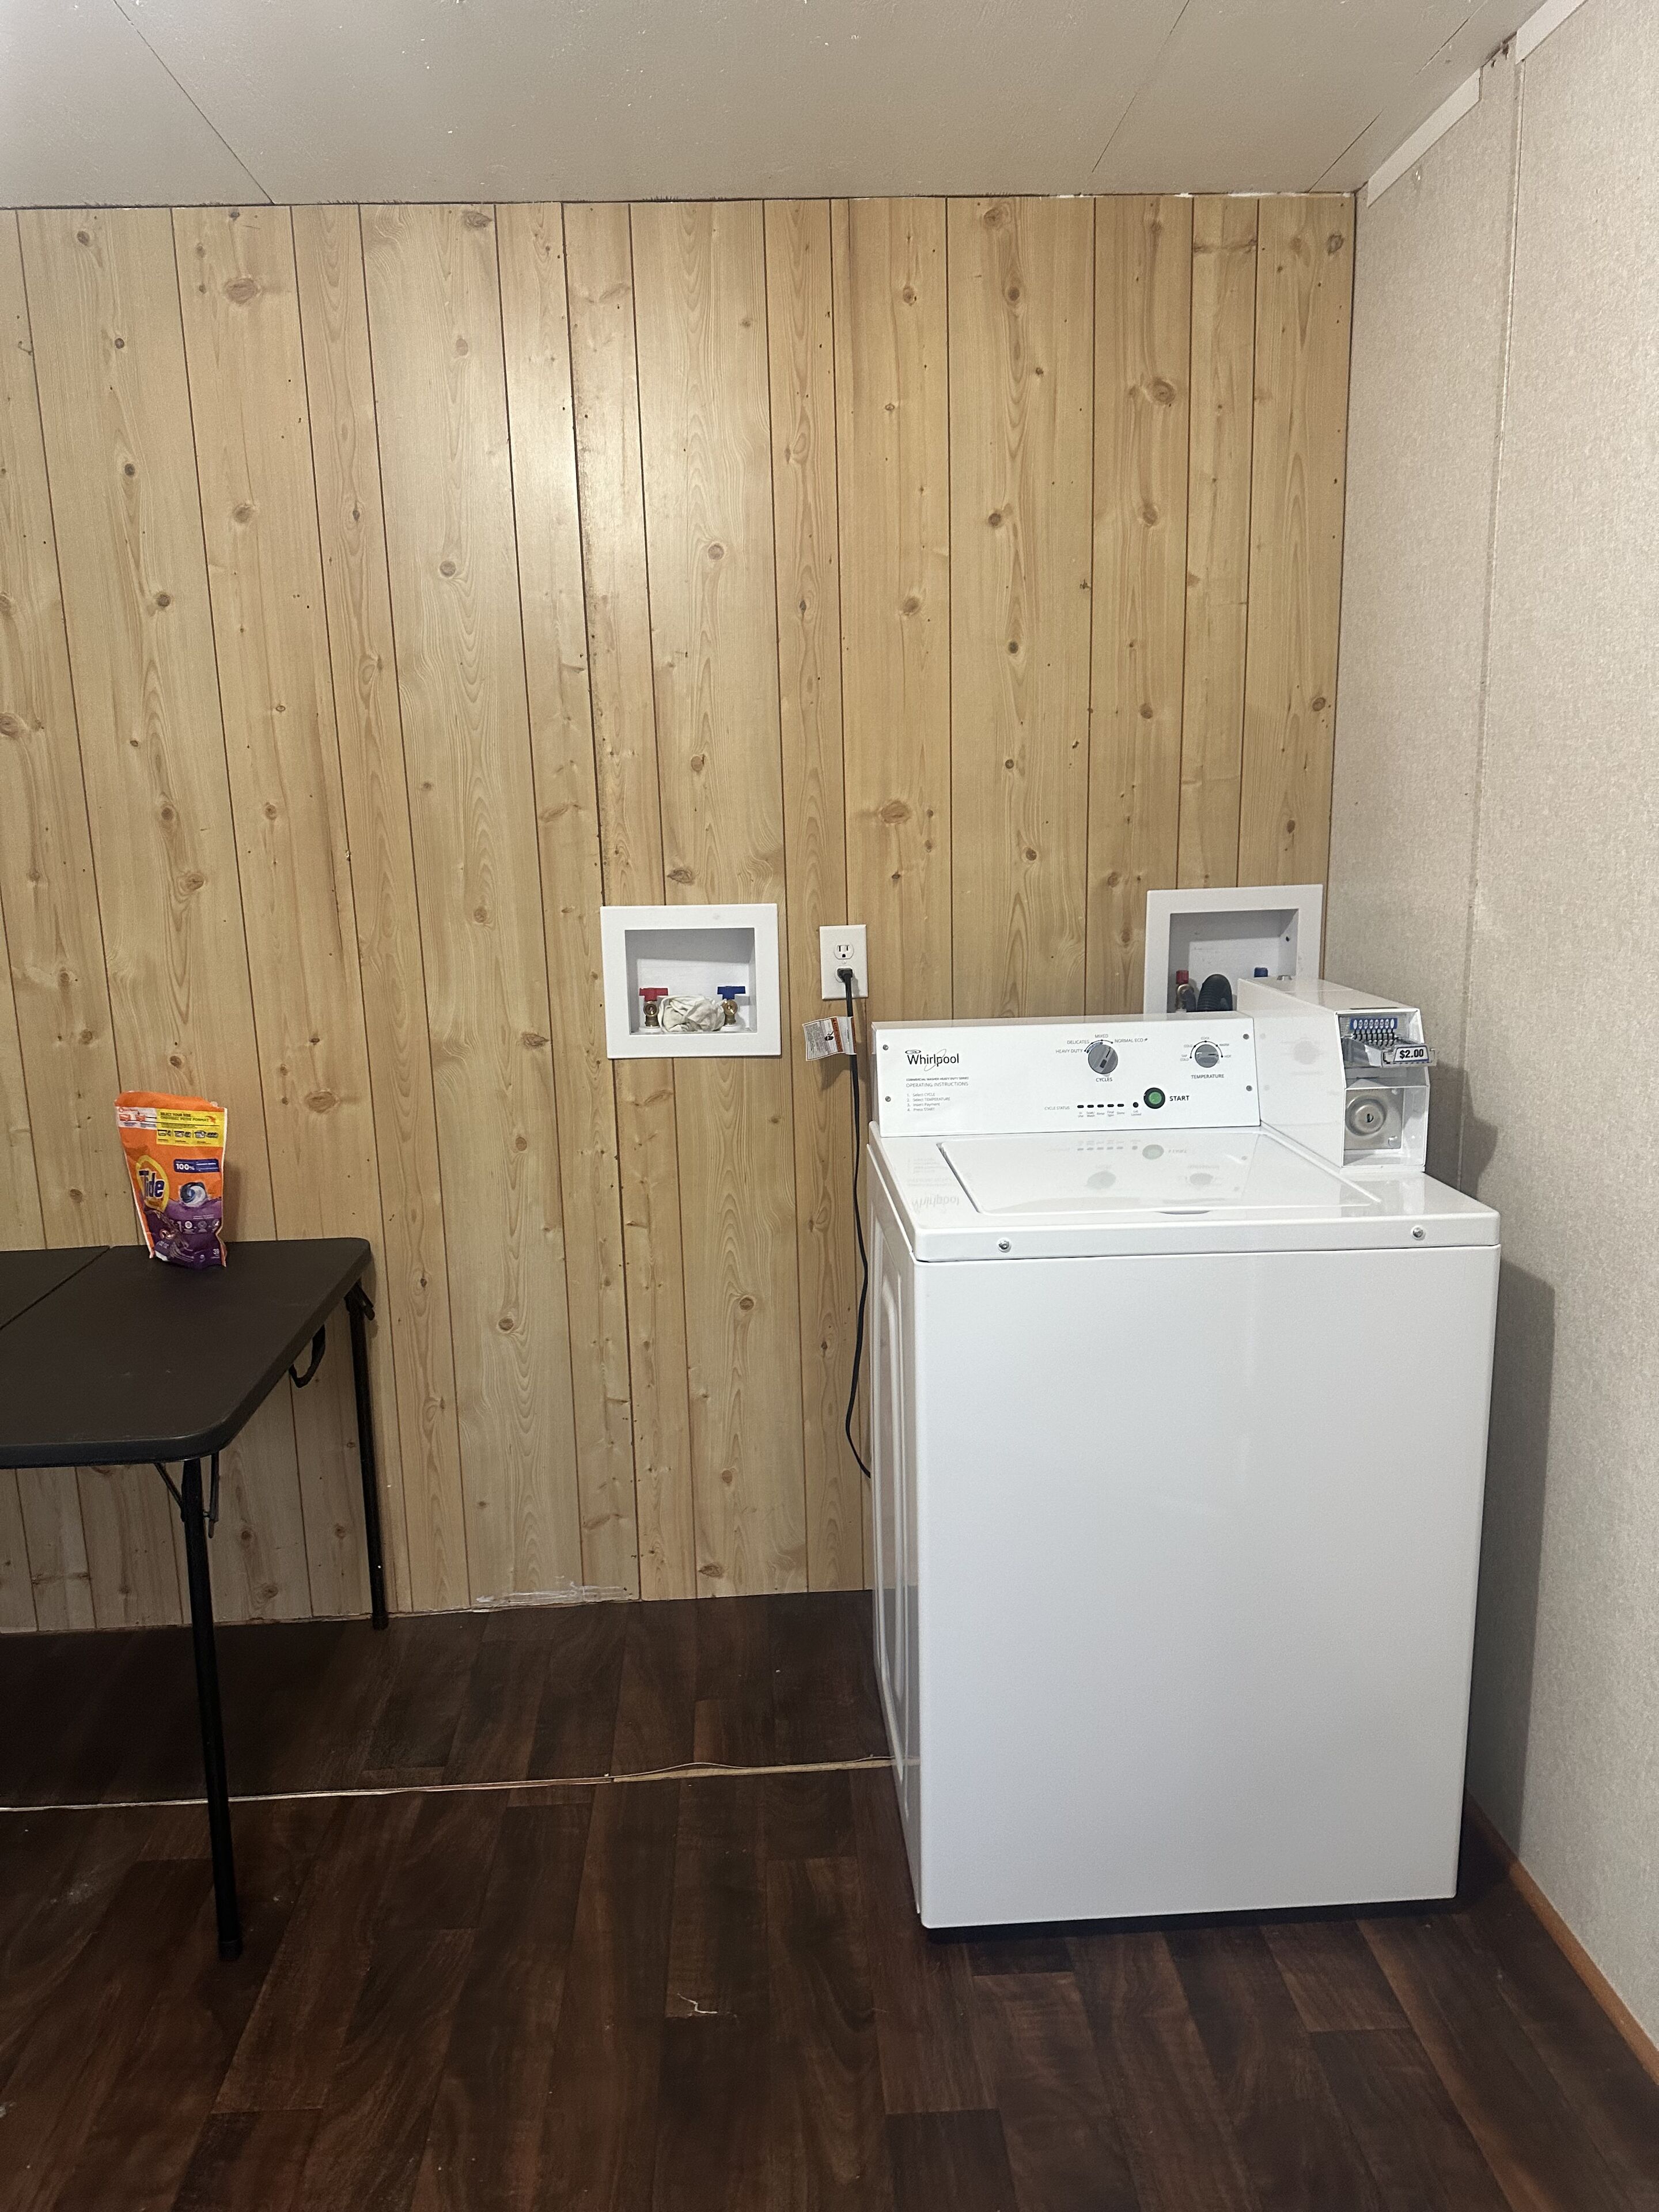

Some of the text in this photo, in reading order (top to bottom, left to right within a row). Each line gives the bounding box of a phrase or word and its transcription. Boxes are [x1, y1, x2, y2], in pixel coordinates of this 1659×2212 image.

[907, 1053, 959, 1067] Whirlpool
[1400, 1049, 1424, 1059] $2.00
[138, 1170, 165, 1198] Tide
